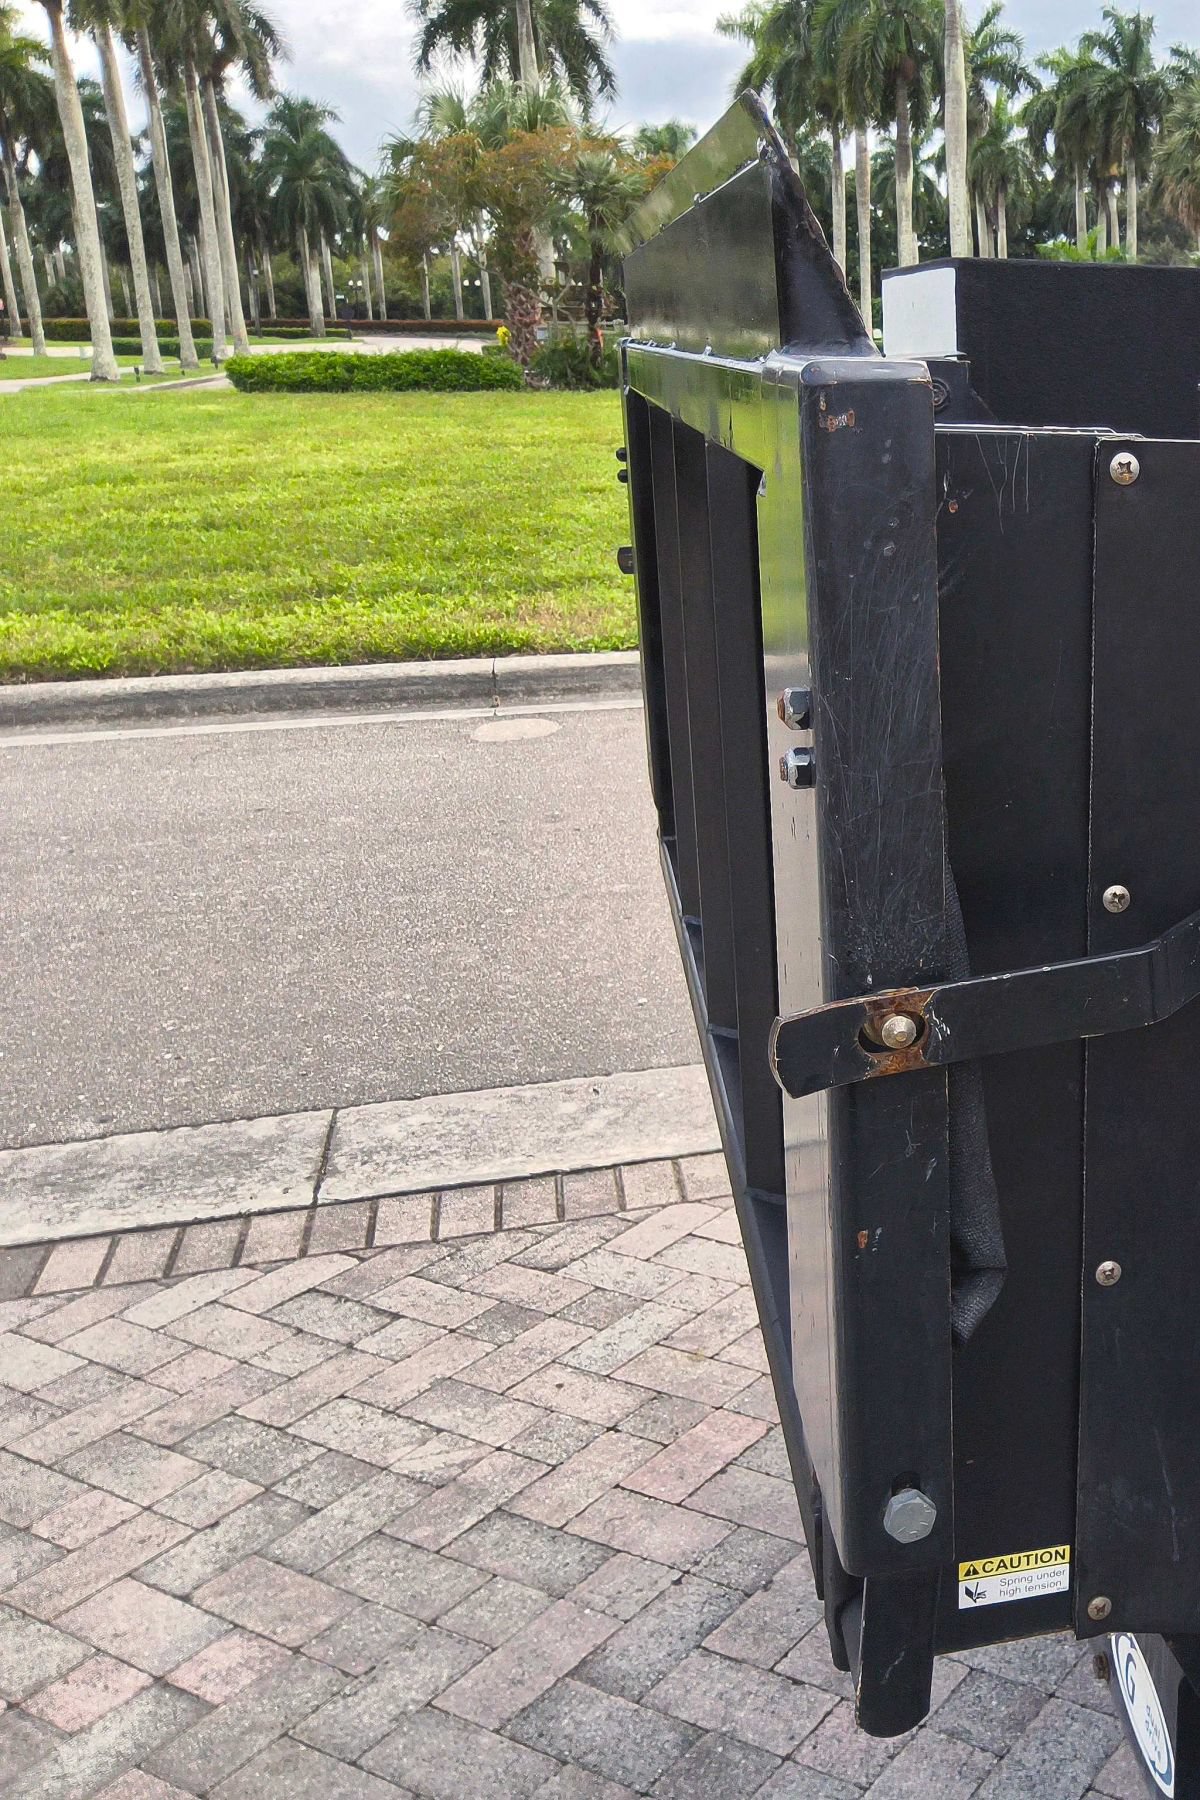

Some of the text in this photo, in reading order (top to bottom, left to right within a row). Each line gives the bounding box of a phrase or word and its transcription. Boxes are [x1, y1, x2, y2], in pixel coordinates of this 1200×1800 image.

[982, 1548, 1066, 1573] CAUTION
[1000, 1569, 1066, 1587] Spring under
[1000, 1581, 1061, 1597] high tension
